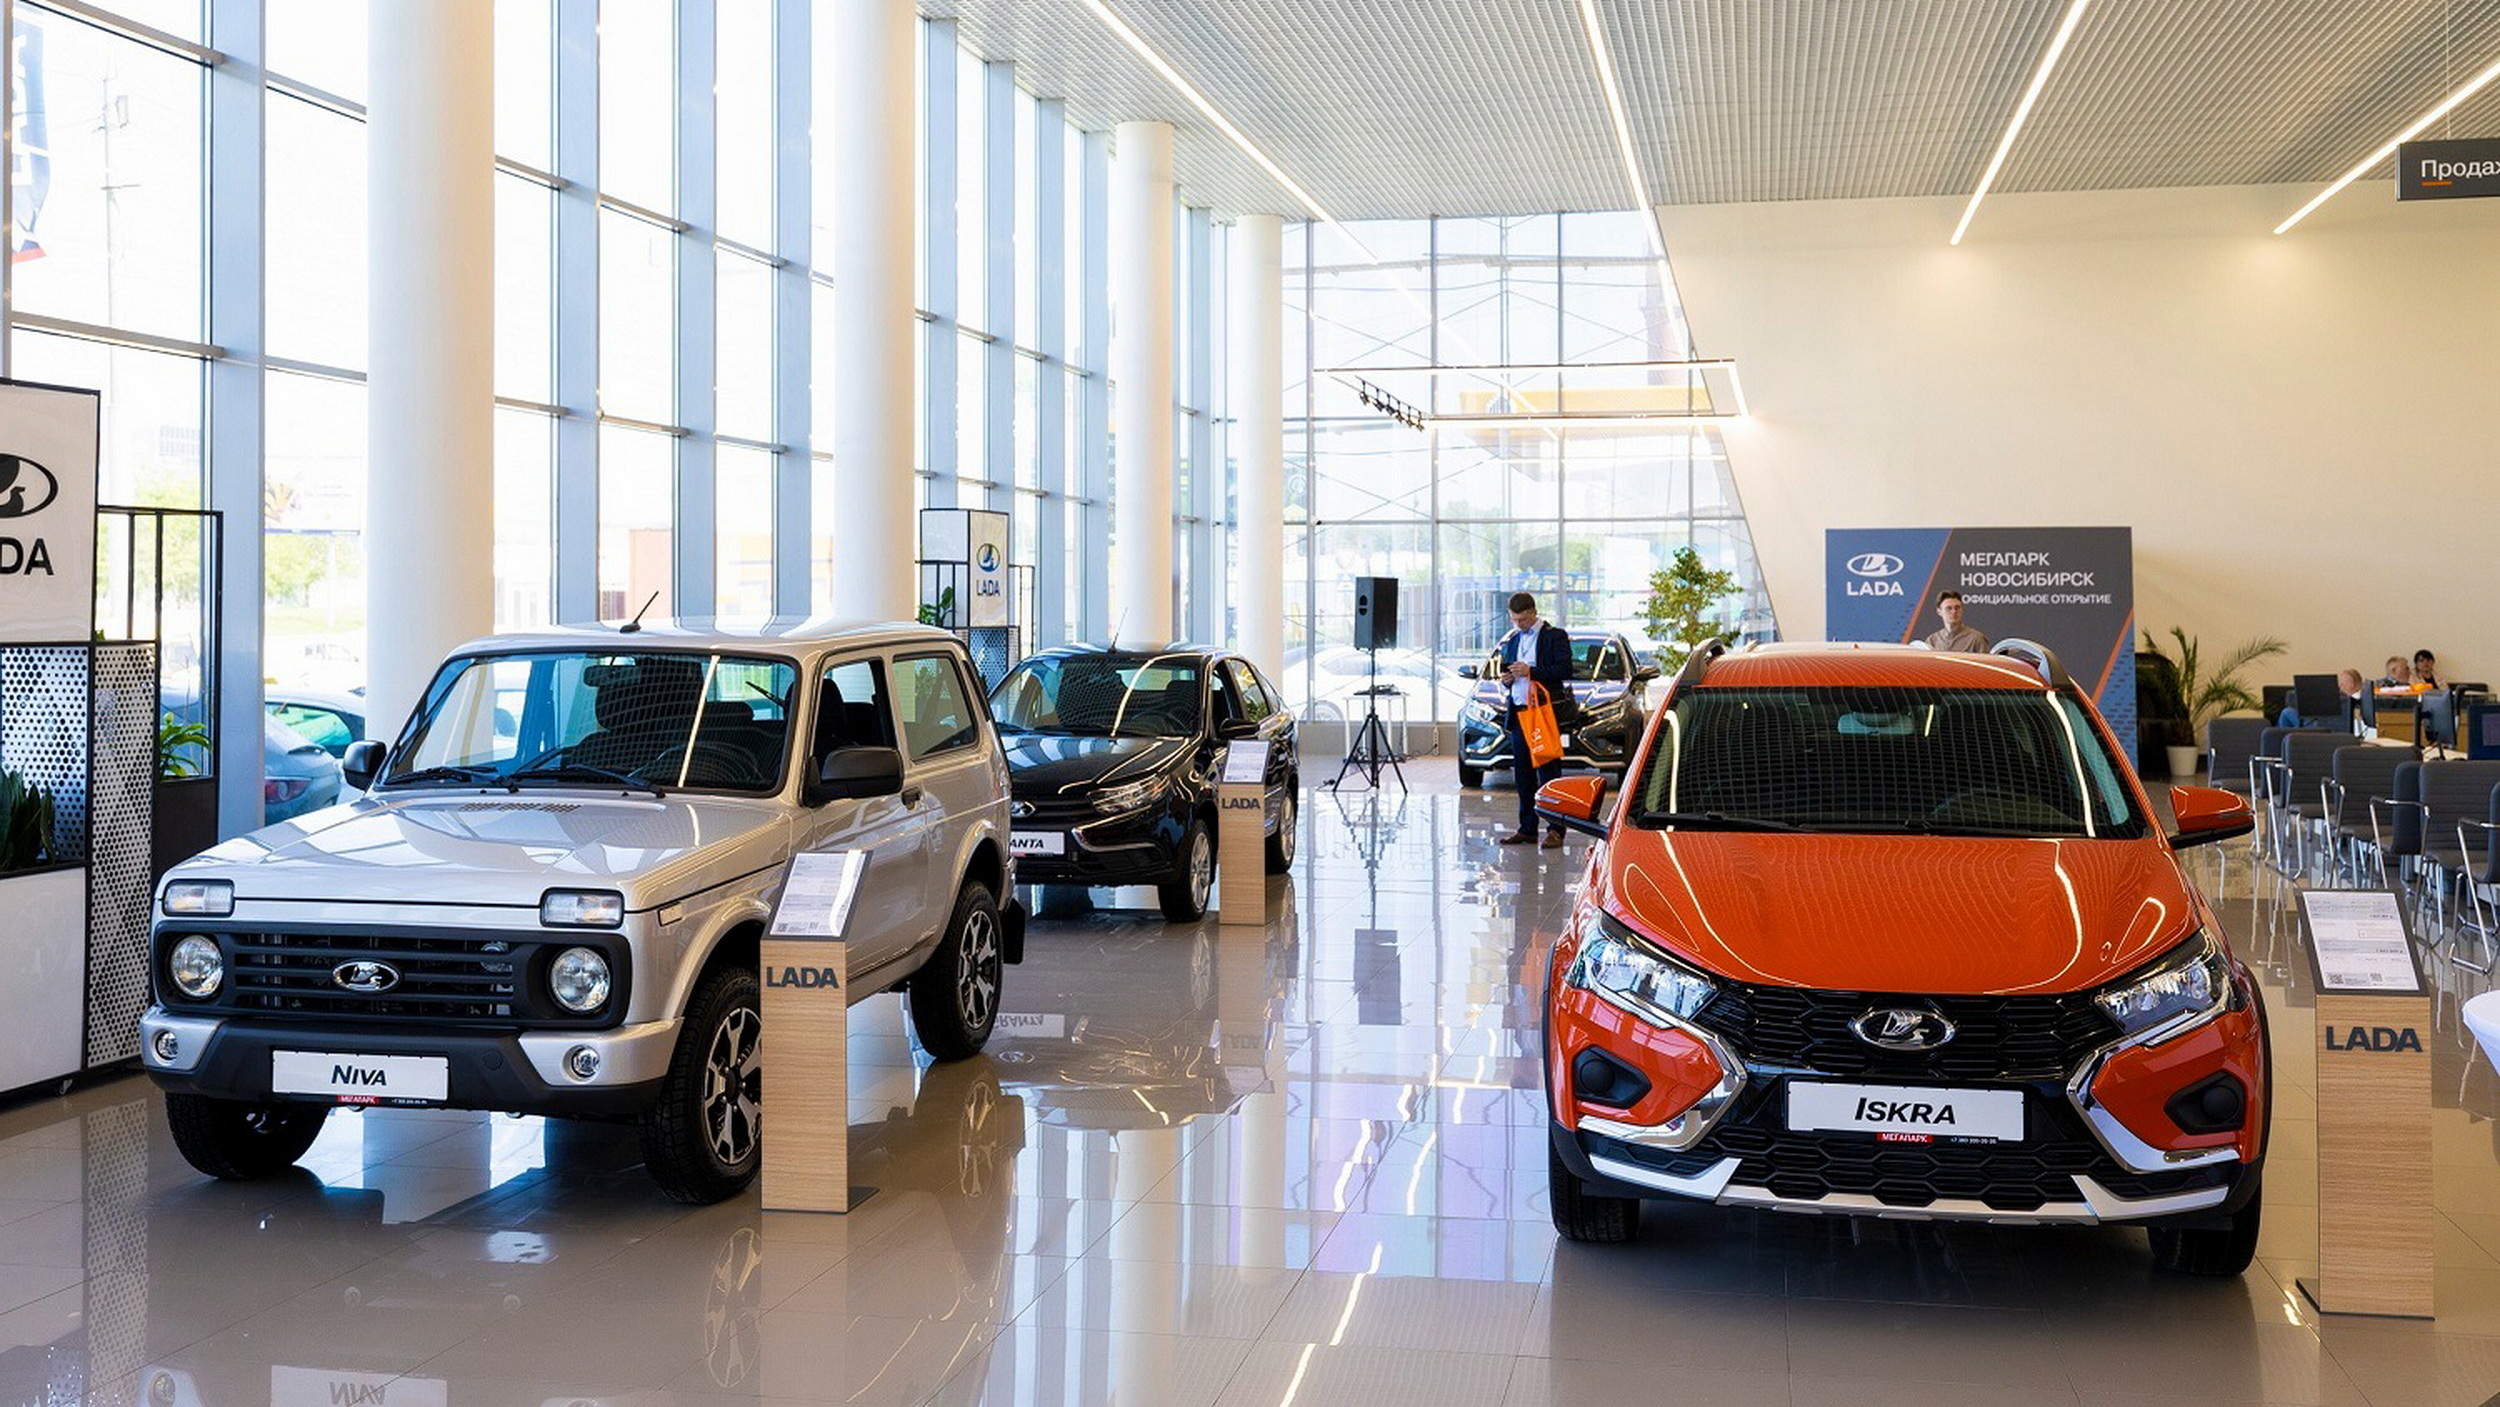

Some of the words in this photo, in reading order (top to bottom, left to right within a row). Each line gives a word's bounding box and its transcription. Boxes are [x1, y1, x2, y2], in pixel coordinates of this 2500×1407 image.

[1960, 552, 2050, 567] МЕГАПАРК
[1960, 571, 2095, 587] НОВОСИБИРСК
[976, 579, 1001, 597] LADA
[1847, 581, 1904, 596] LADA
[1961, 593, 2049, 605] ОФИЦИАЛЬНОЕ
[2050, 593, 2112, 604] ОТКРЫТИЕ
[1221, 797, 1261, 809] LADA
[766, 966, 840, 989] LADA
[2326, 1026, 2423, 1052] LADA
[331, 1065, 387, 1086] NIVA
[1854, 1097, 1956, 1125] ISKRA
